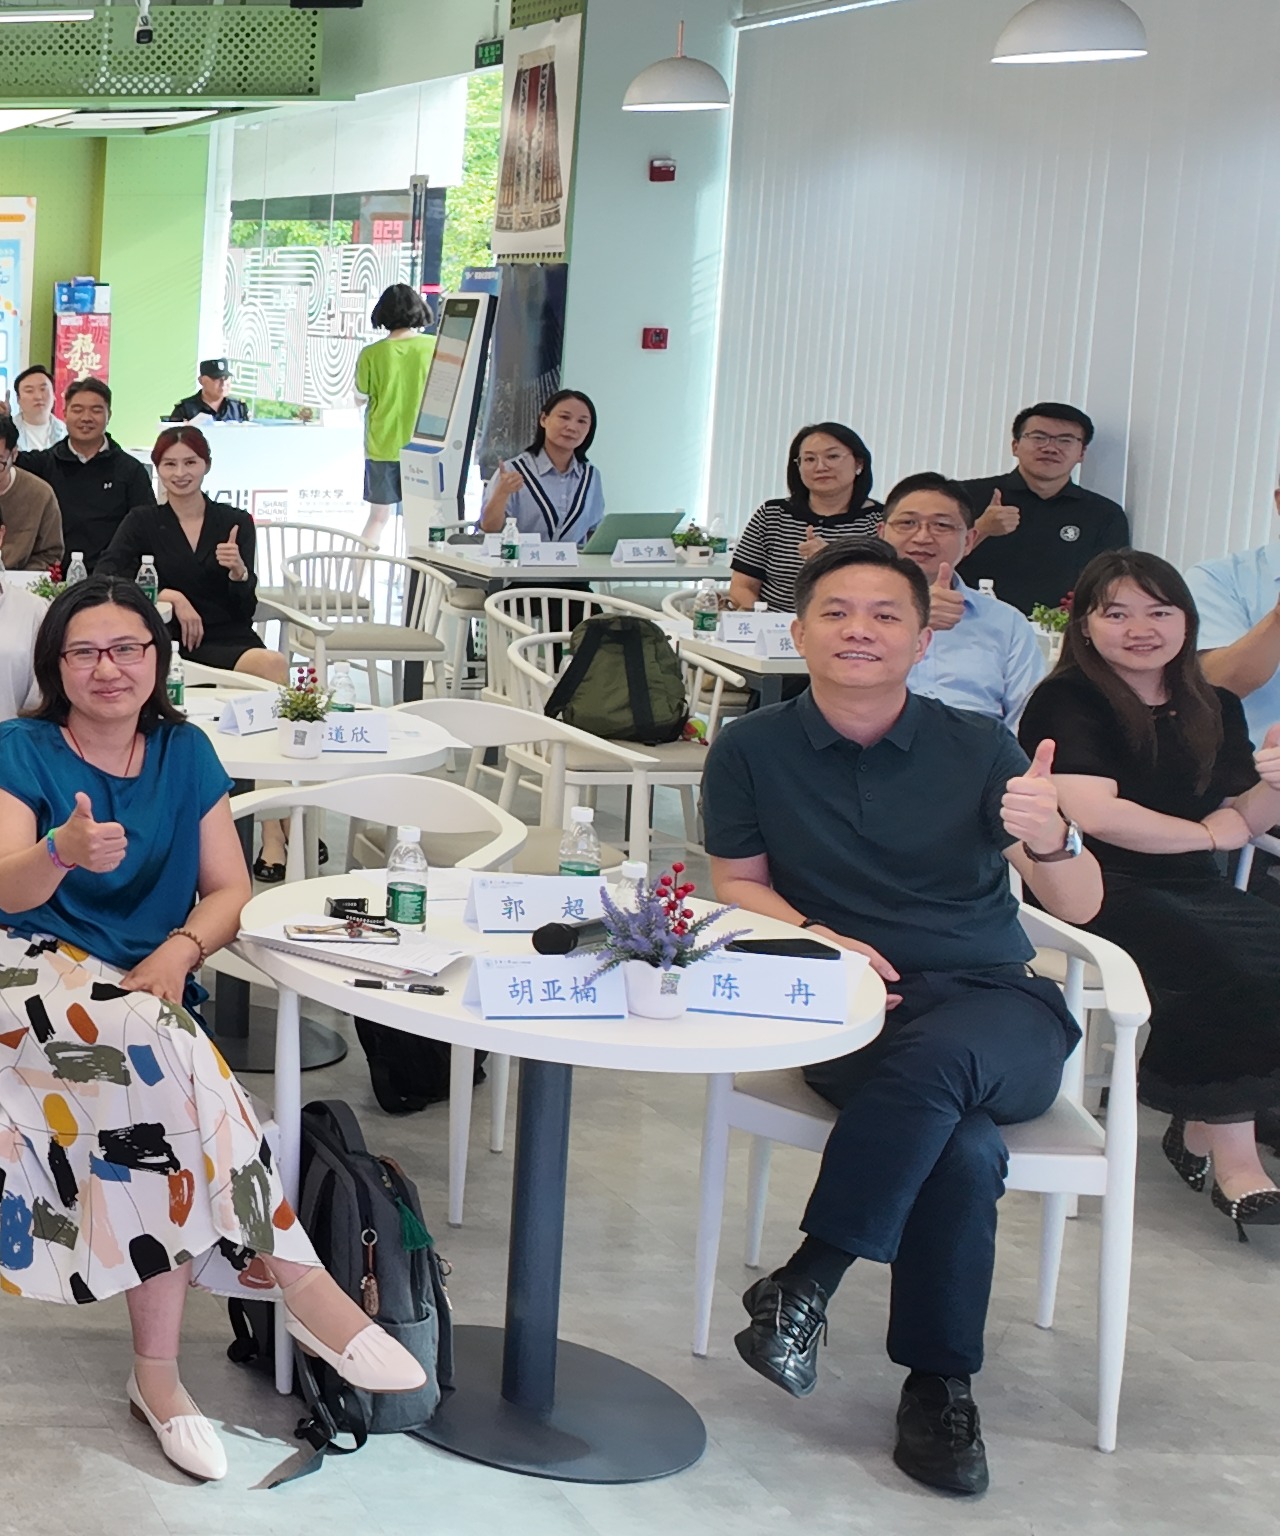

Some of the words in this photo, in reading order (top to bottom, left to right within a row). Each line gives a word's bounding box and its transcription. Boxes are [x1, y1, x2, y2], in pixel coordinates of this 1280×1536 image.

[321, 725, 371, 744] 道欣
[501, 895, 526, 922] 郭
[561, 895, 589, 921] 超
[508, 976, 597, 1005] 胡亚楠
[712, 972, 741, 1001] 陈
[784, 977, 816, 1006] 冉
